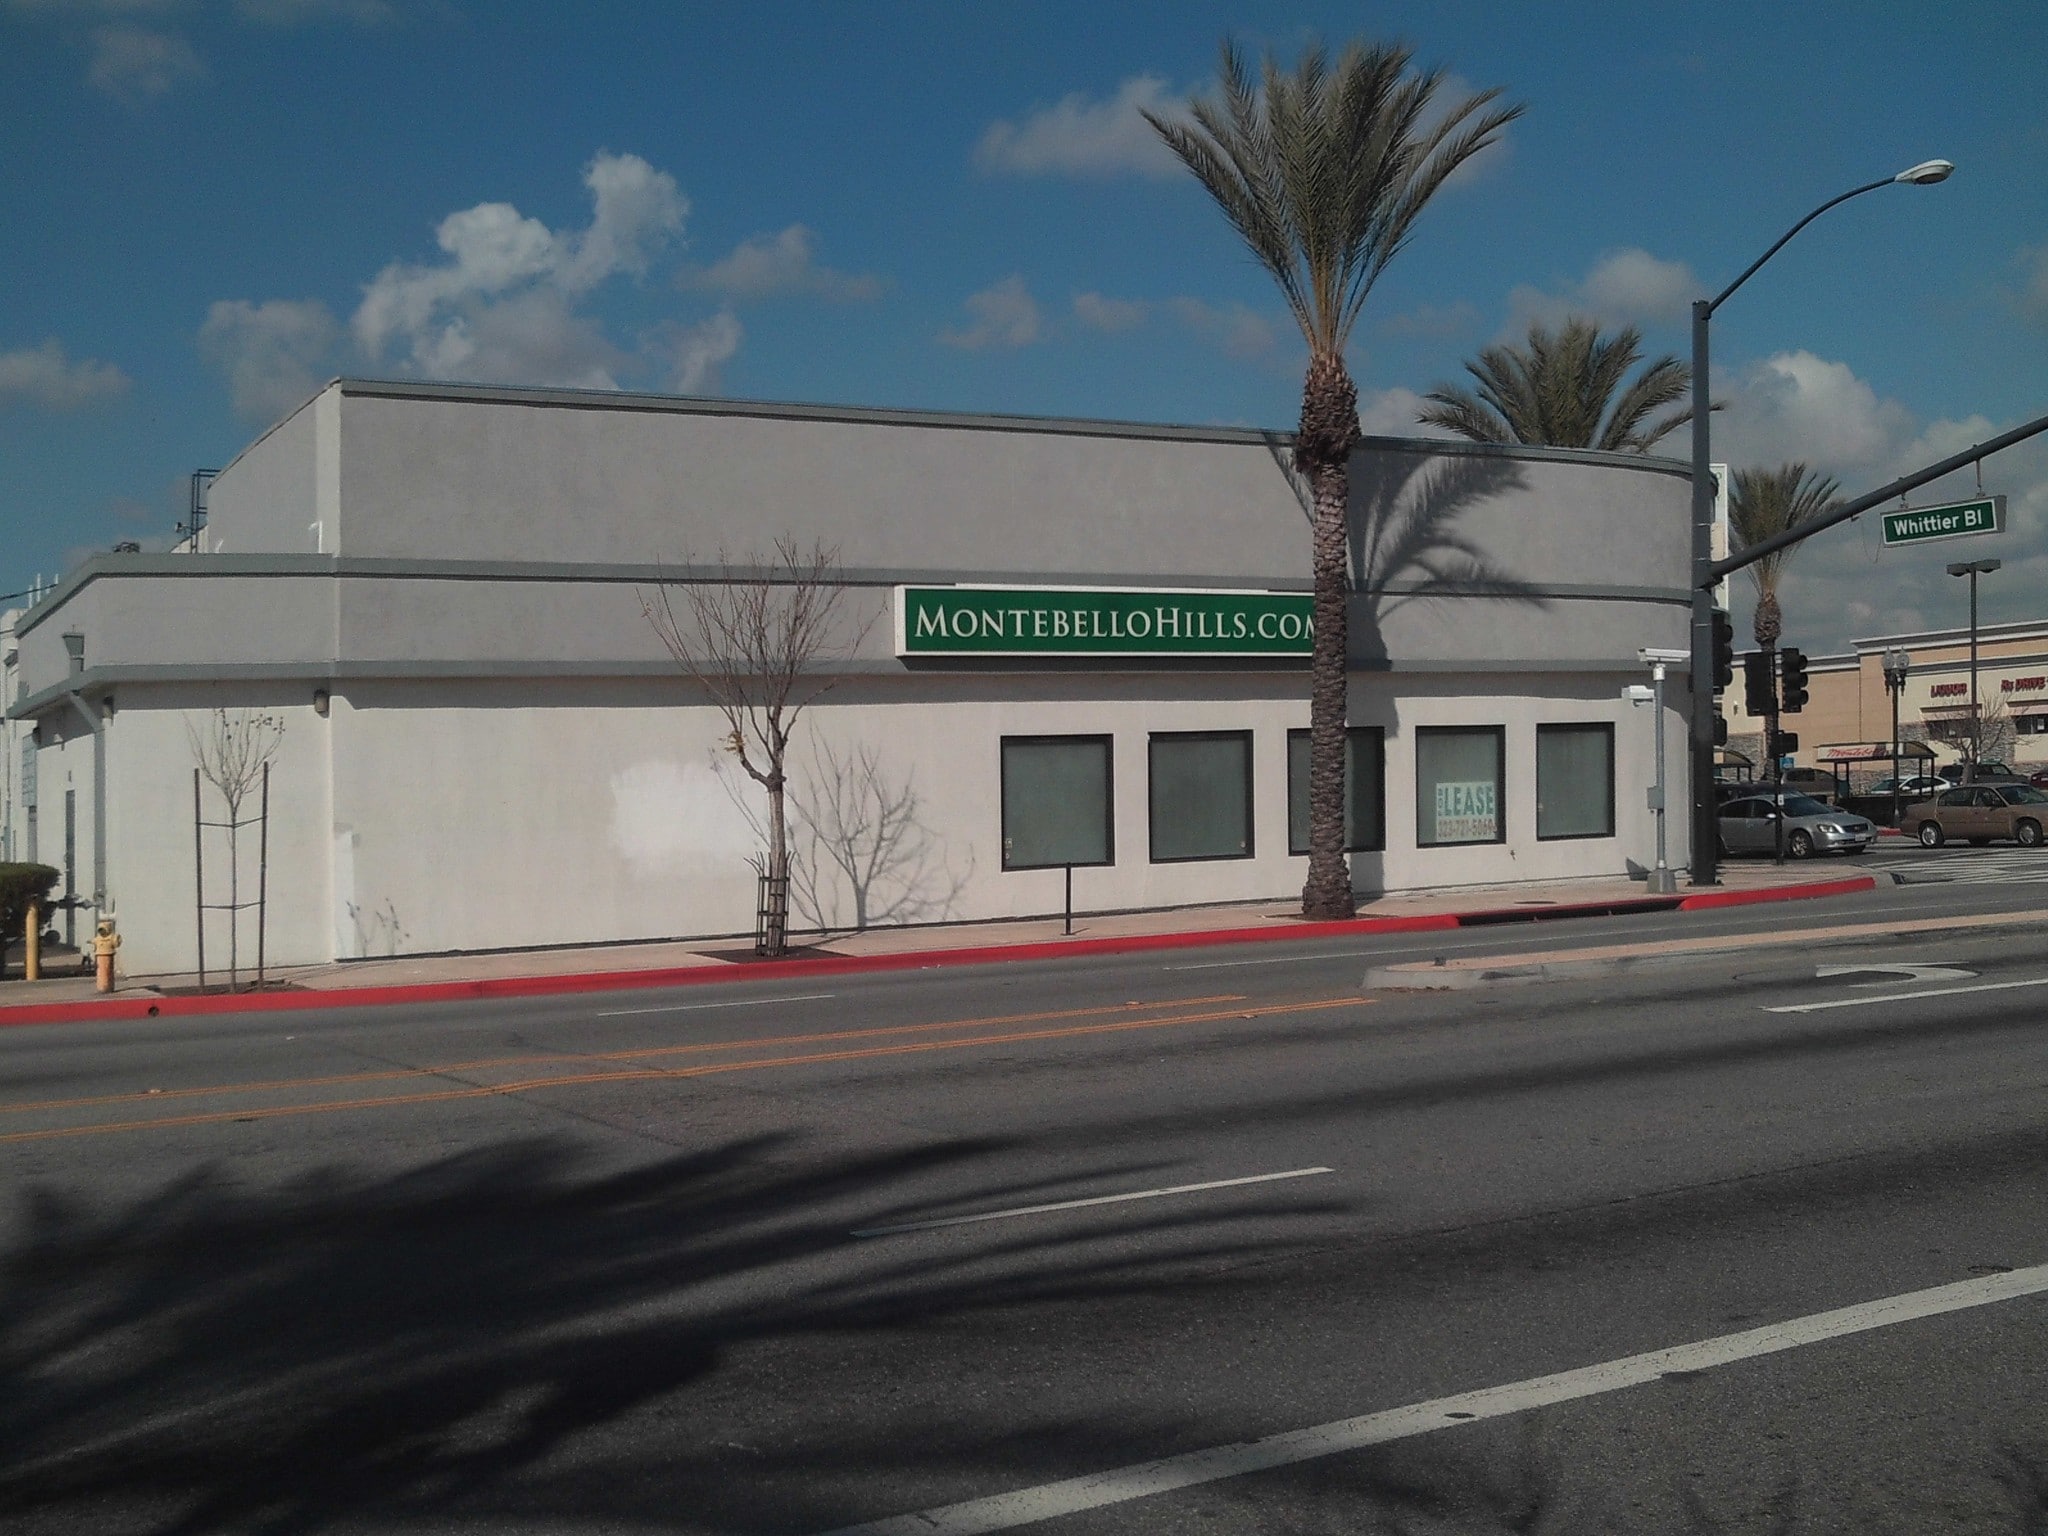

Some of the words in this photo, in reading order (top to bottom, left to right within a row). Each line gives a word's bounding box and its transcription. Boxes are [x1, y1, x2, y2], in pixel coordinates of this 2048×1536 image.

[1893, 514, 1960, 536] Whittier
[1964, 509, 1982, 527] Bl
[1445, 785, 1494, 816] LEASE
